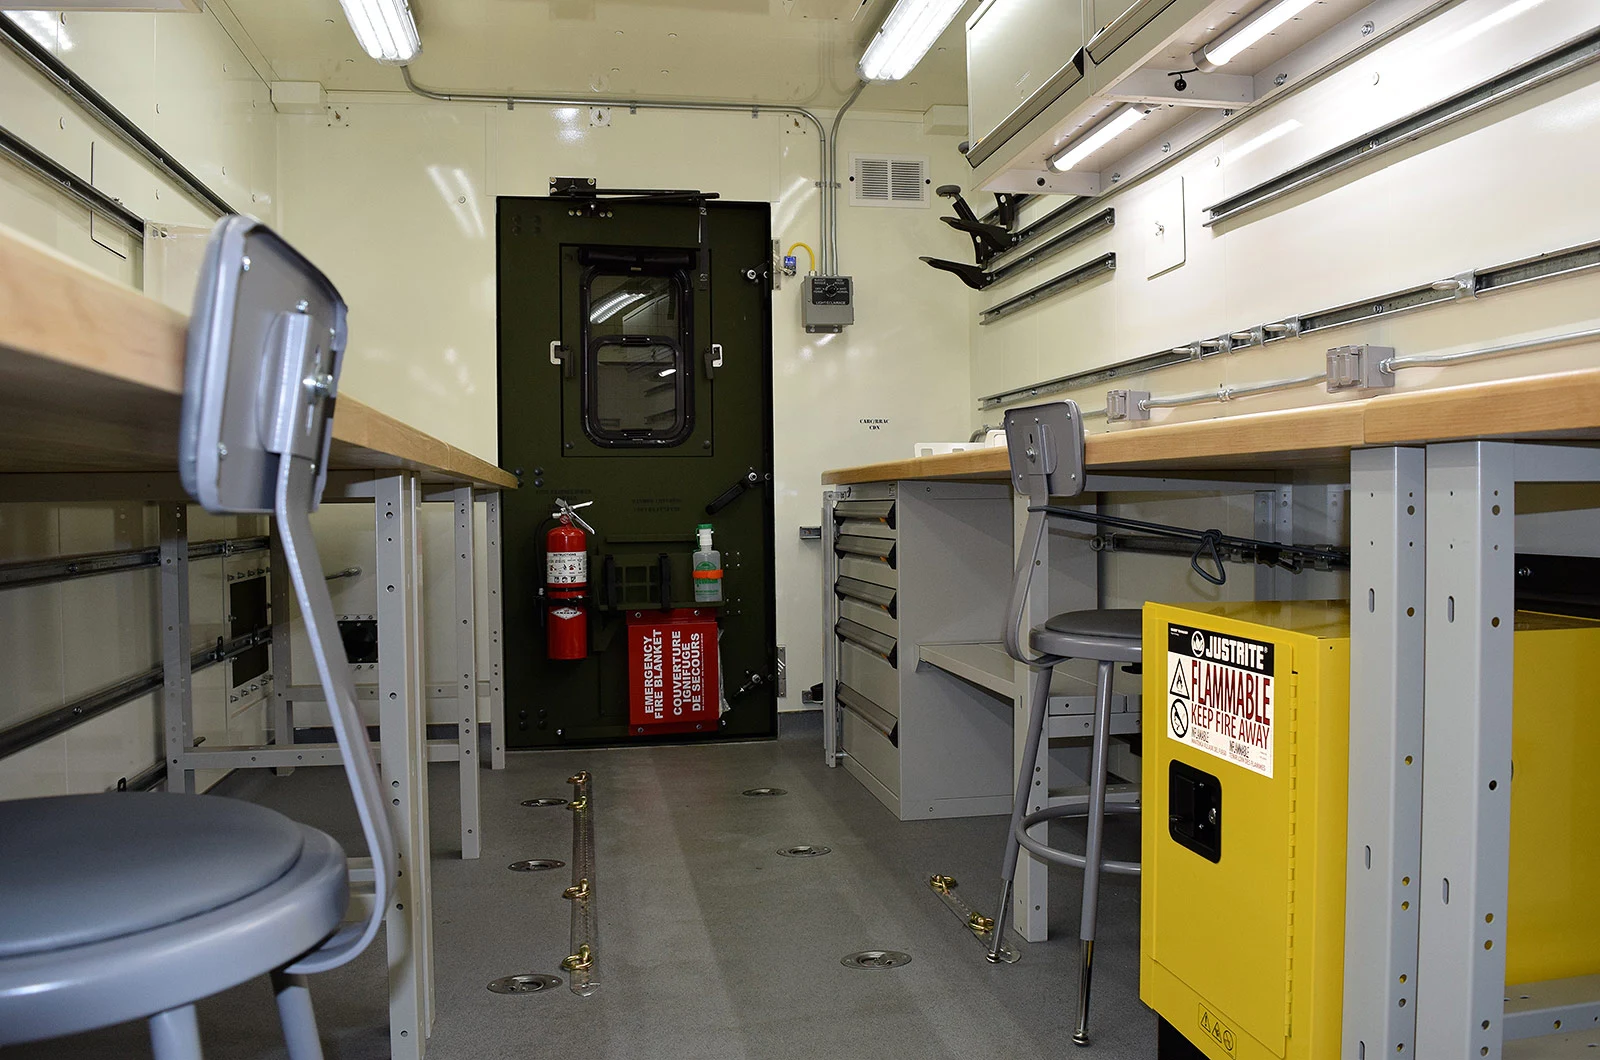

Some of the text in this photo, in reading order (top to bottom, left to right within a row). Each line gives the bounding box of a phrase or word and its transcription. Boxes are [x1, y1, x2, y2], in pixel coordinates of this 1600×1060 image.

[643, 636, 653, 714] EMERGENCY
[653, 629, 664, 719] FIRE BLANKET
[672, 630, 682, 716] COUVERTURE
[682, 643, 691, 703] IGNIFUGE
[690, 633, 701, 711] DE SECOURS
[1191, 659, 1271, 726] FLAMMABLE
[1191, 703, 1214, 730] KEEP
[1216, 710, 1237, 739] FIRE
[1238, 719, 1270, 750] AWAY
